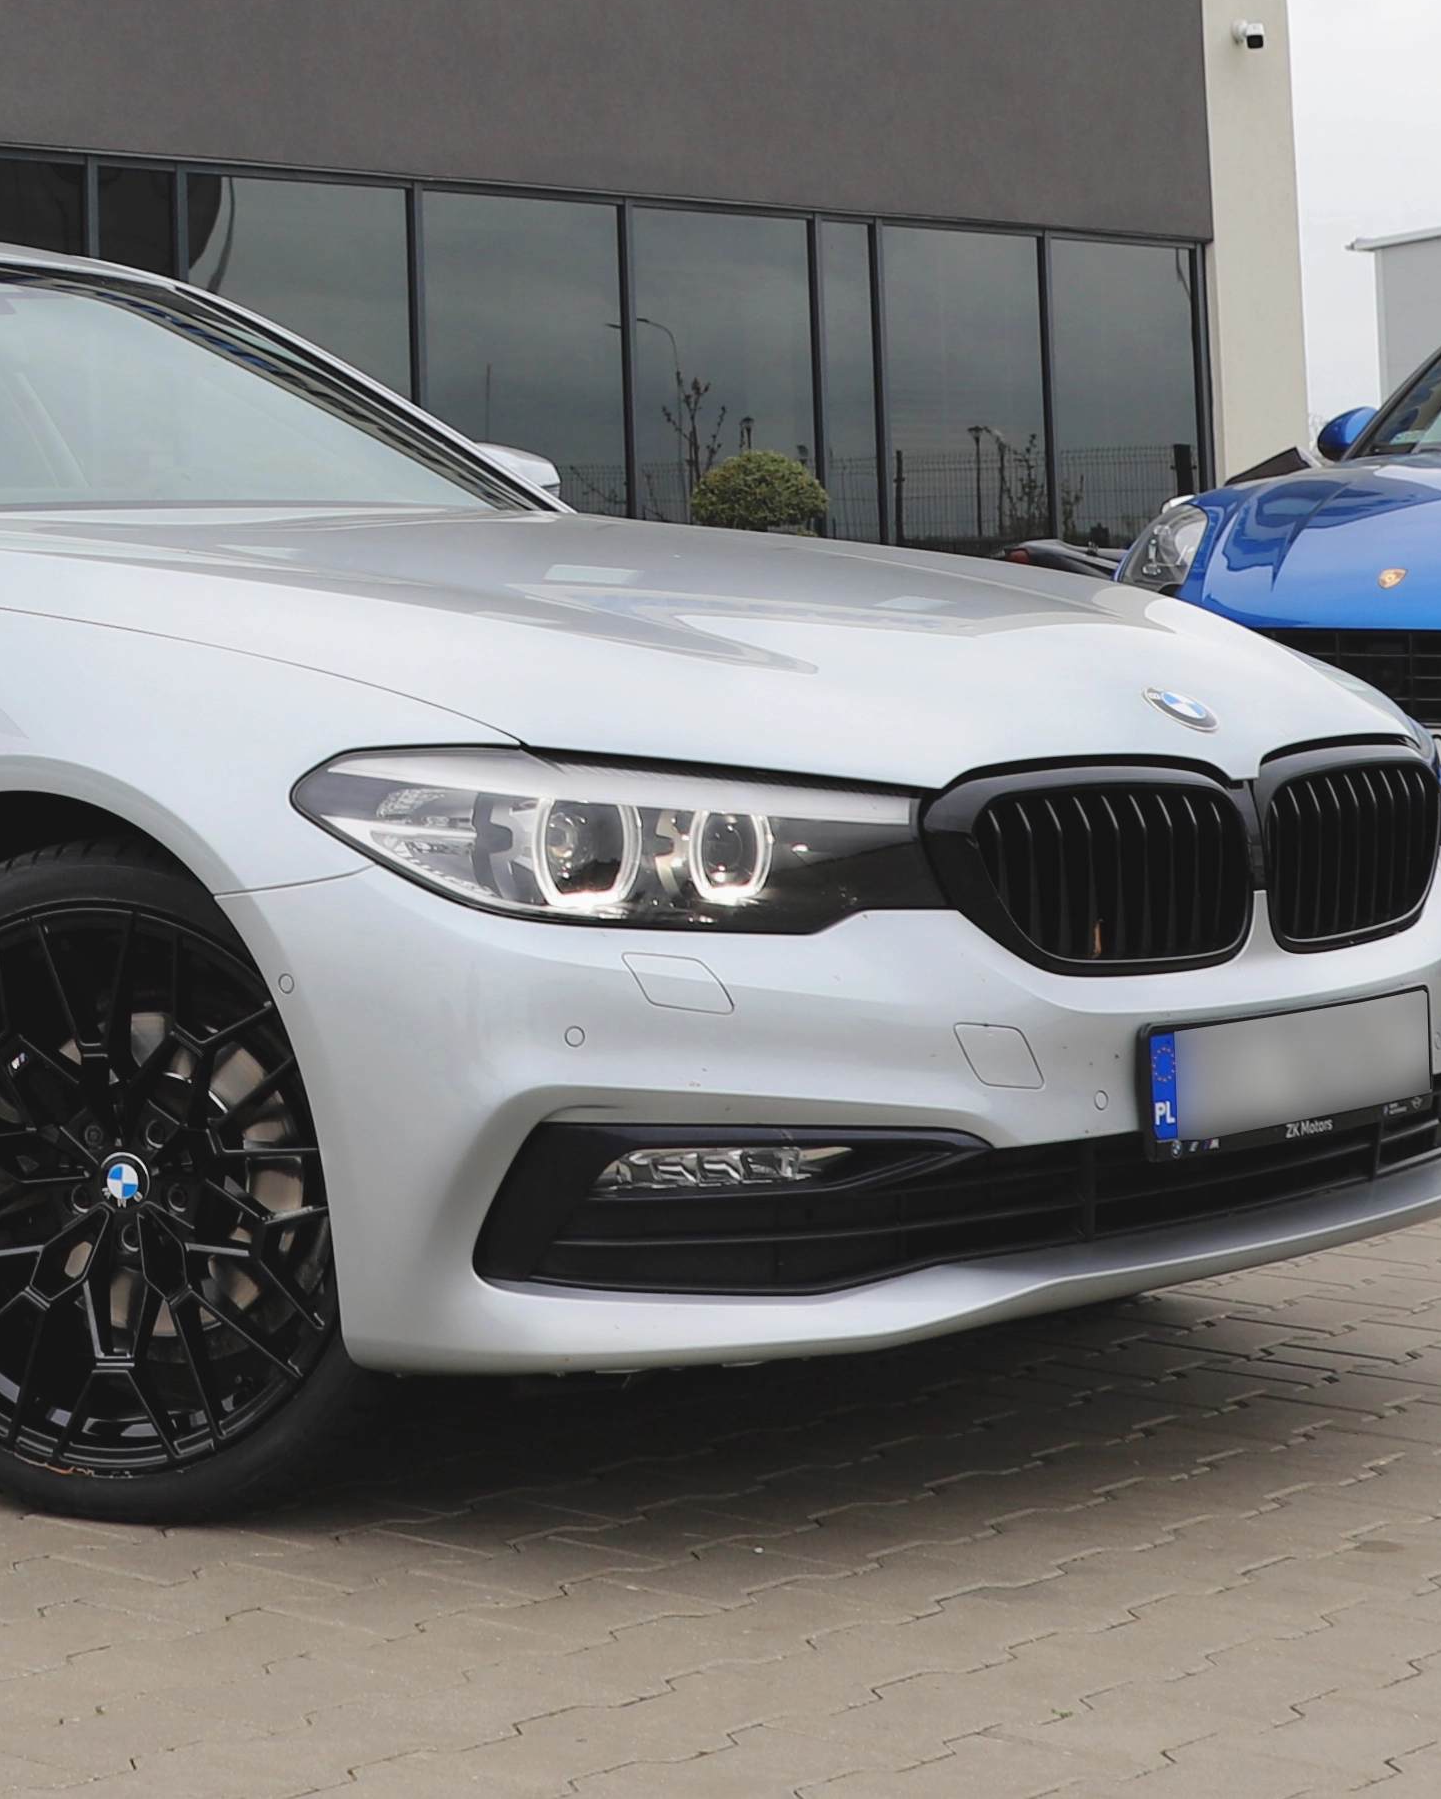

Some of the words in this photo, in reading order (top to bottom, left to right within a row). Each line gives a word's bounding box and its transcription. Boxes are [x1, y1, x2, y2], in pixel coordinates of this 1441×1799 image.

[1154, 1100, 1176, 1126] PL
[1284, 1121, 1301, 1139] ZK
[1301, 1117, 1334, 1136] Motors
